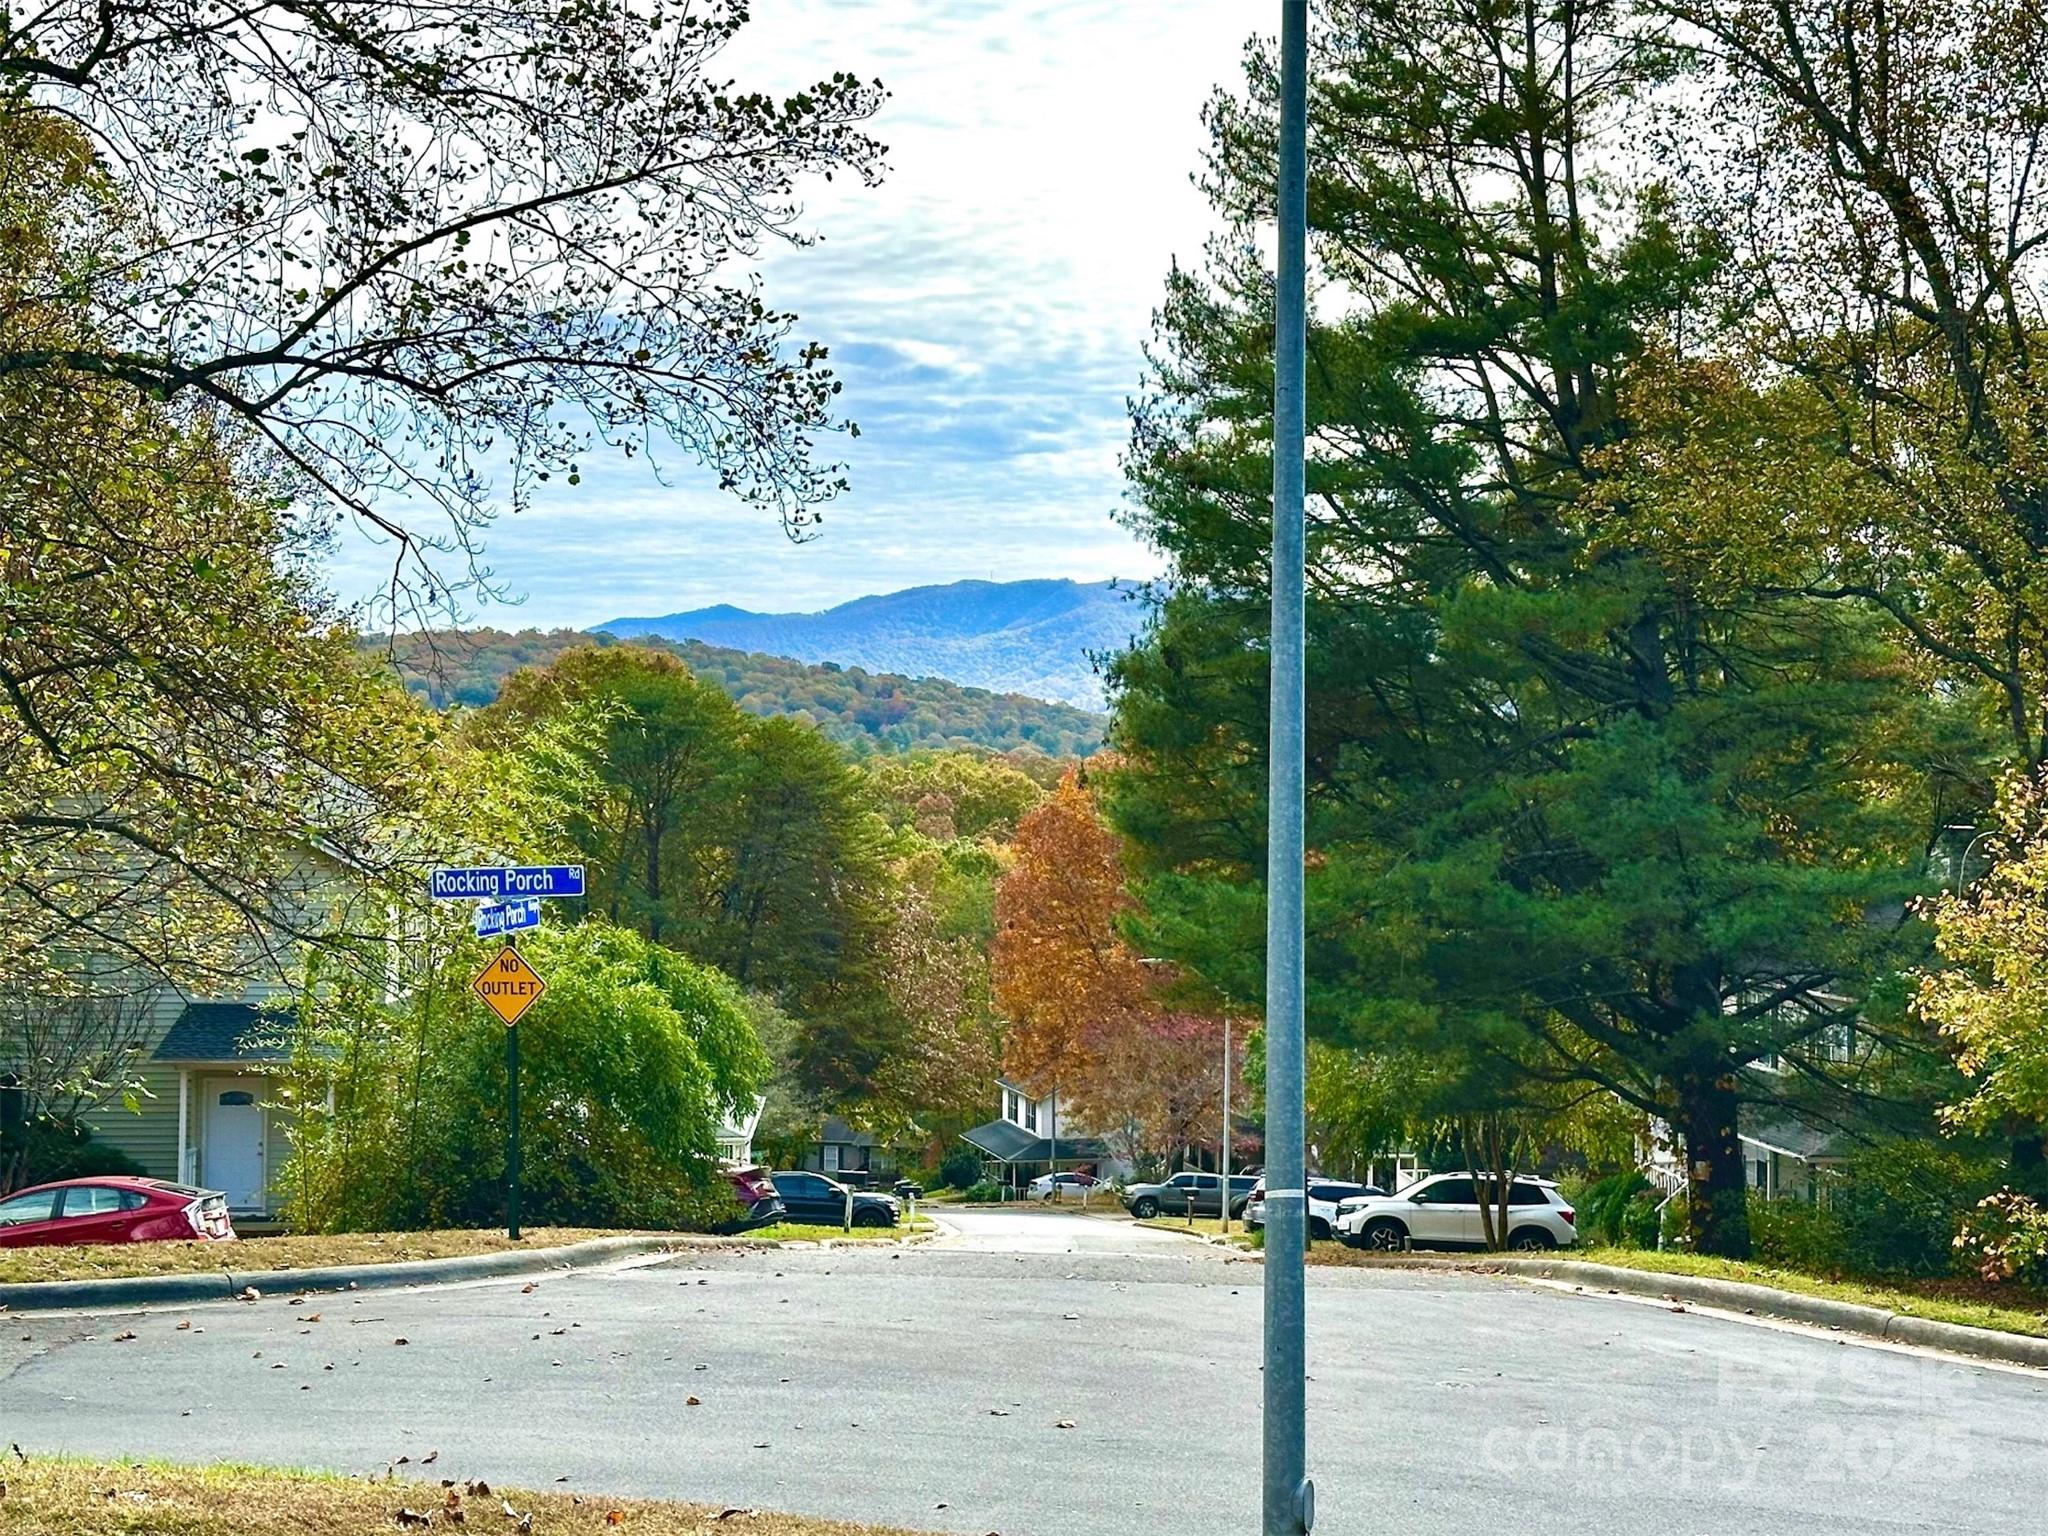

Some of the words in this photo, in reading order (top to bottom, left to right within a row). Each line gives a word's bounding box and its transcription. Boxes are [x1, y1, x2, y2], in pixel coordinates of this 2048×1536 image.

[435, 871, 499, 895] Rocking
[505, 869, 554, 891] Porch
[568, 867, 580, 879] Rd
[477, 908, 505, 932] Rocking
[506, 901, 527, 926] Porch
[500, 959, 519, 973] NO
[482, 981, 536, 995] OUTLET
